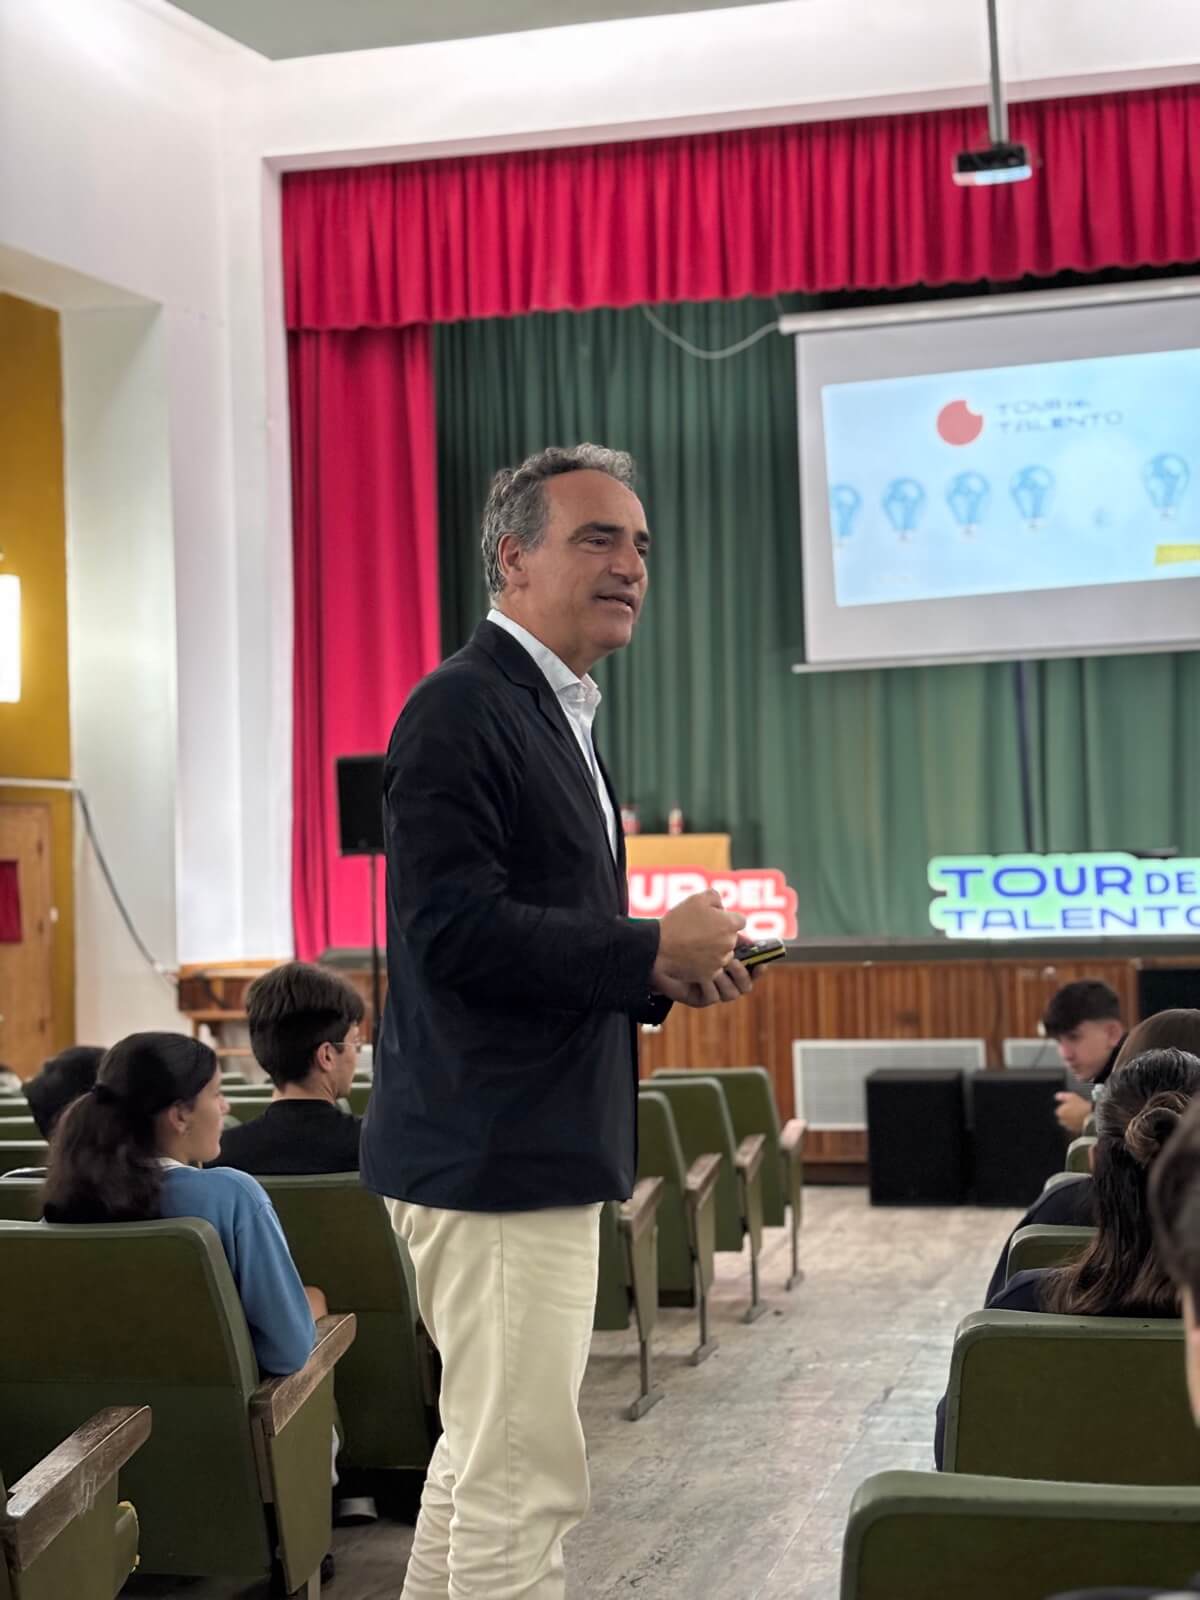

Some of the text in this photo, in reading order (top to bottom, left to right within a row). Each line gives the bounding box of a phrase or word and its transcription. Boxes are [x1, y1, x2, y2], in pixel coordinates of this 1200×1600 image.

[711, 879, 785, 908] DEL
[939, 866, 1198, 898] TOUR DE
